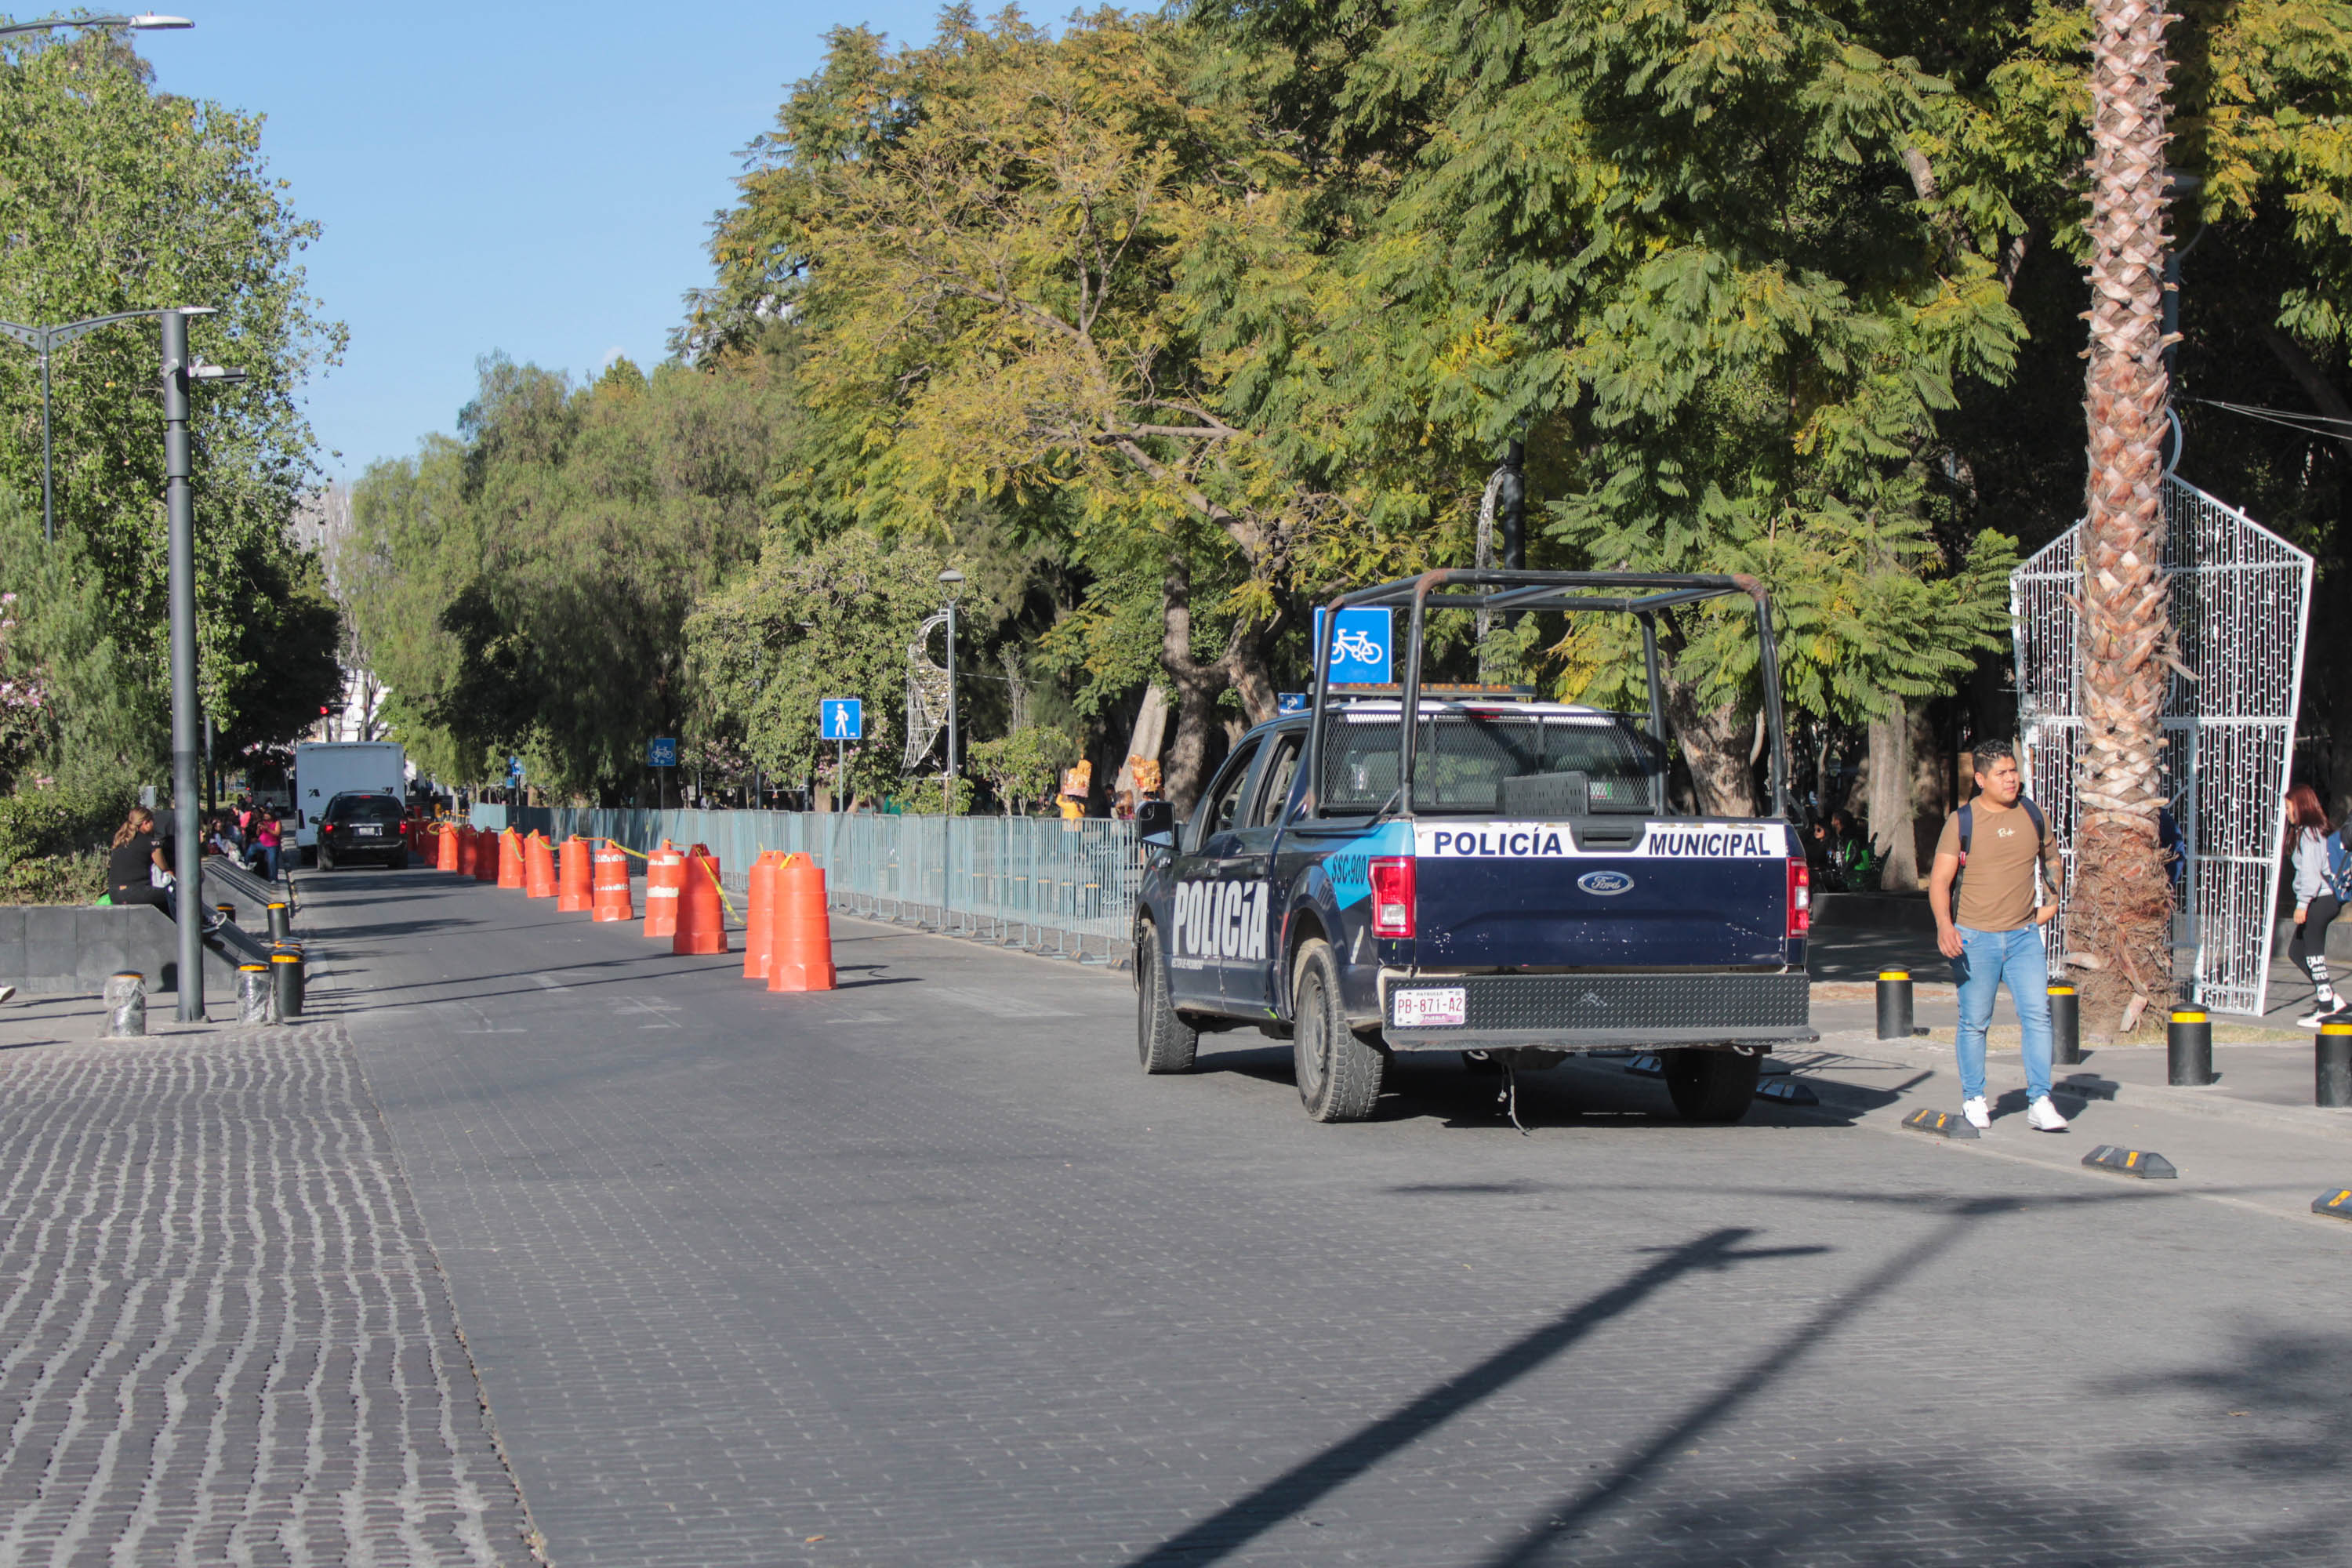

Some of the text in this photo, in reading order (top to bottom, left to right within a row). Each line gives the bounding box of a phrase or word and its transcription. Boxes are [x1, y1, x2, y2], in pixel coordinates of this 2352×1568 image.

[1434, 826, 1770, 856] POLICÍA MUNICIPAL
[1332, 854, 1367, 884] SSC-900
[1592, 876, 1621, 889] Ford
[1173, 880, 1269, 960] POLICÍA
[1398, 997, 1462, 1014] PB-871-A2
